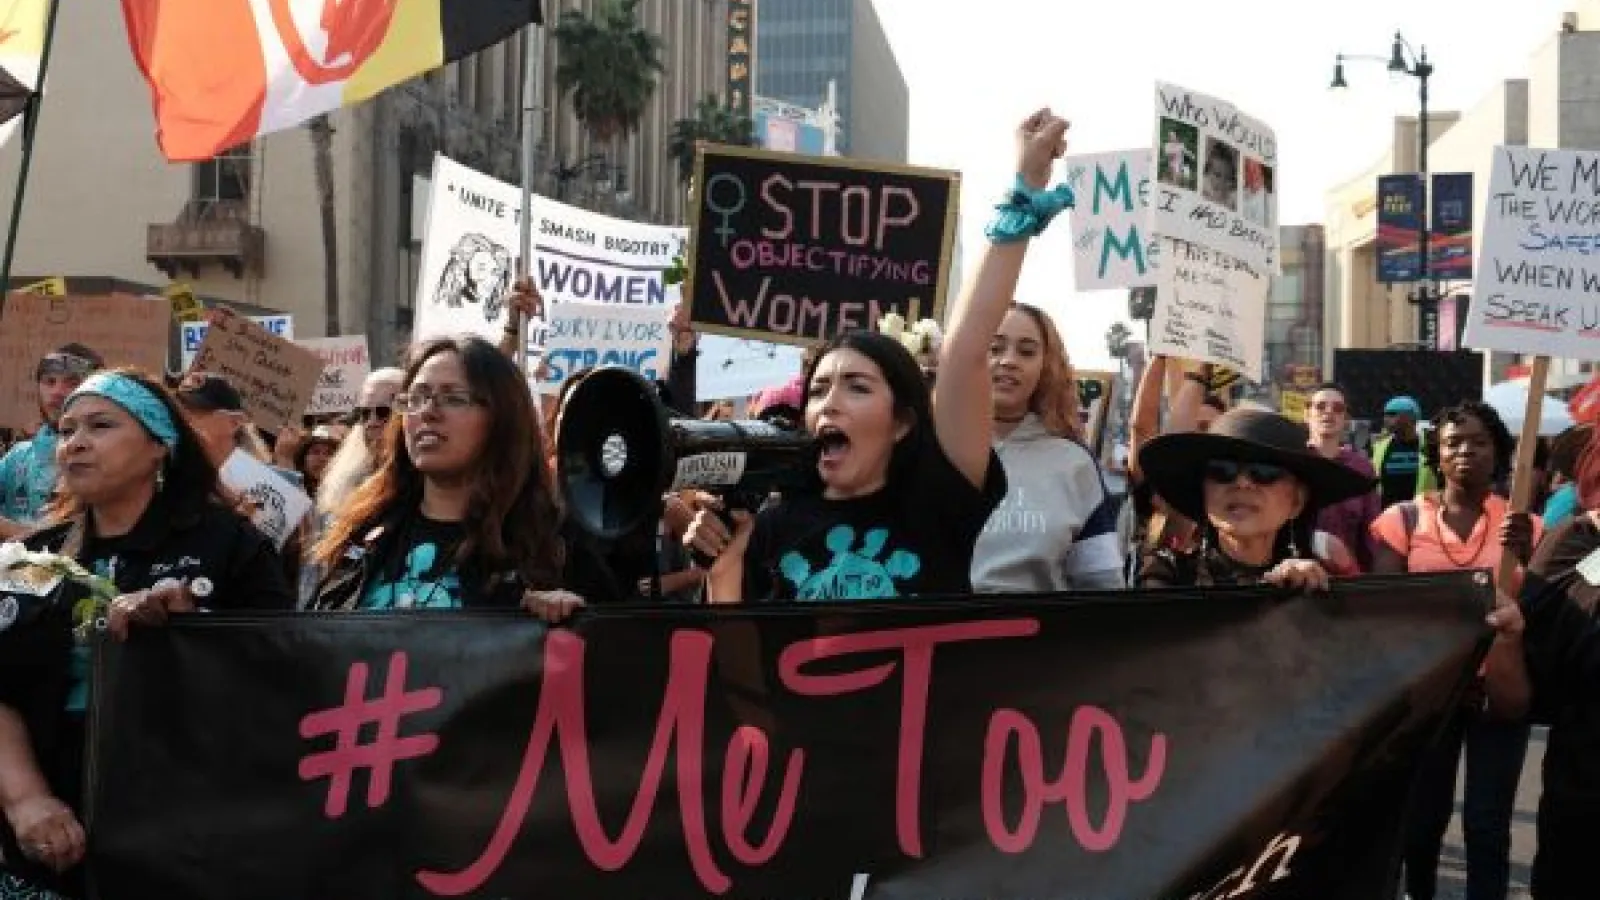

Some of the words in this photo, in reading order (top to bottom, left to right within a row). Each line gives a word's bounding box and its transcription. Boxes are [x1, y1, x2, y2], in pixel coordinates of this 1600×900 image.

[1506, 150, 1559, 192] WE
[1570, 155, 1600, 196] M
[459, 186, 505, 218] UNITE
[538, 218, 596, 246] SMASH
[603, 234, 669, 256] BIGOTRY
[759, 171, 921, 250] STOP
[1492, 191, 1538, 221] THE
[537, 257, 666, 304] WOMEN
[730, 239, 930, 285] OBJECTIFYING
[1493, 256, 1574, 290] WHEN
[550, 316, 663, 341] SURVIVOR
[1484, 293, 1569, 328] SPEAK
